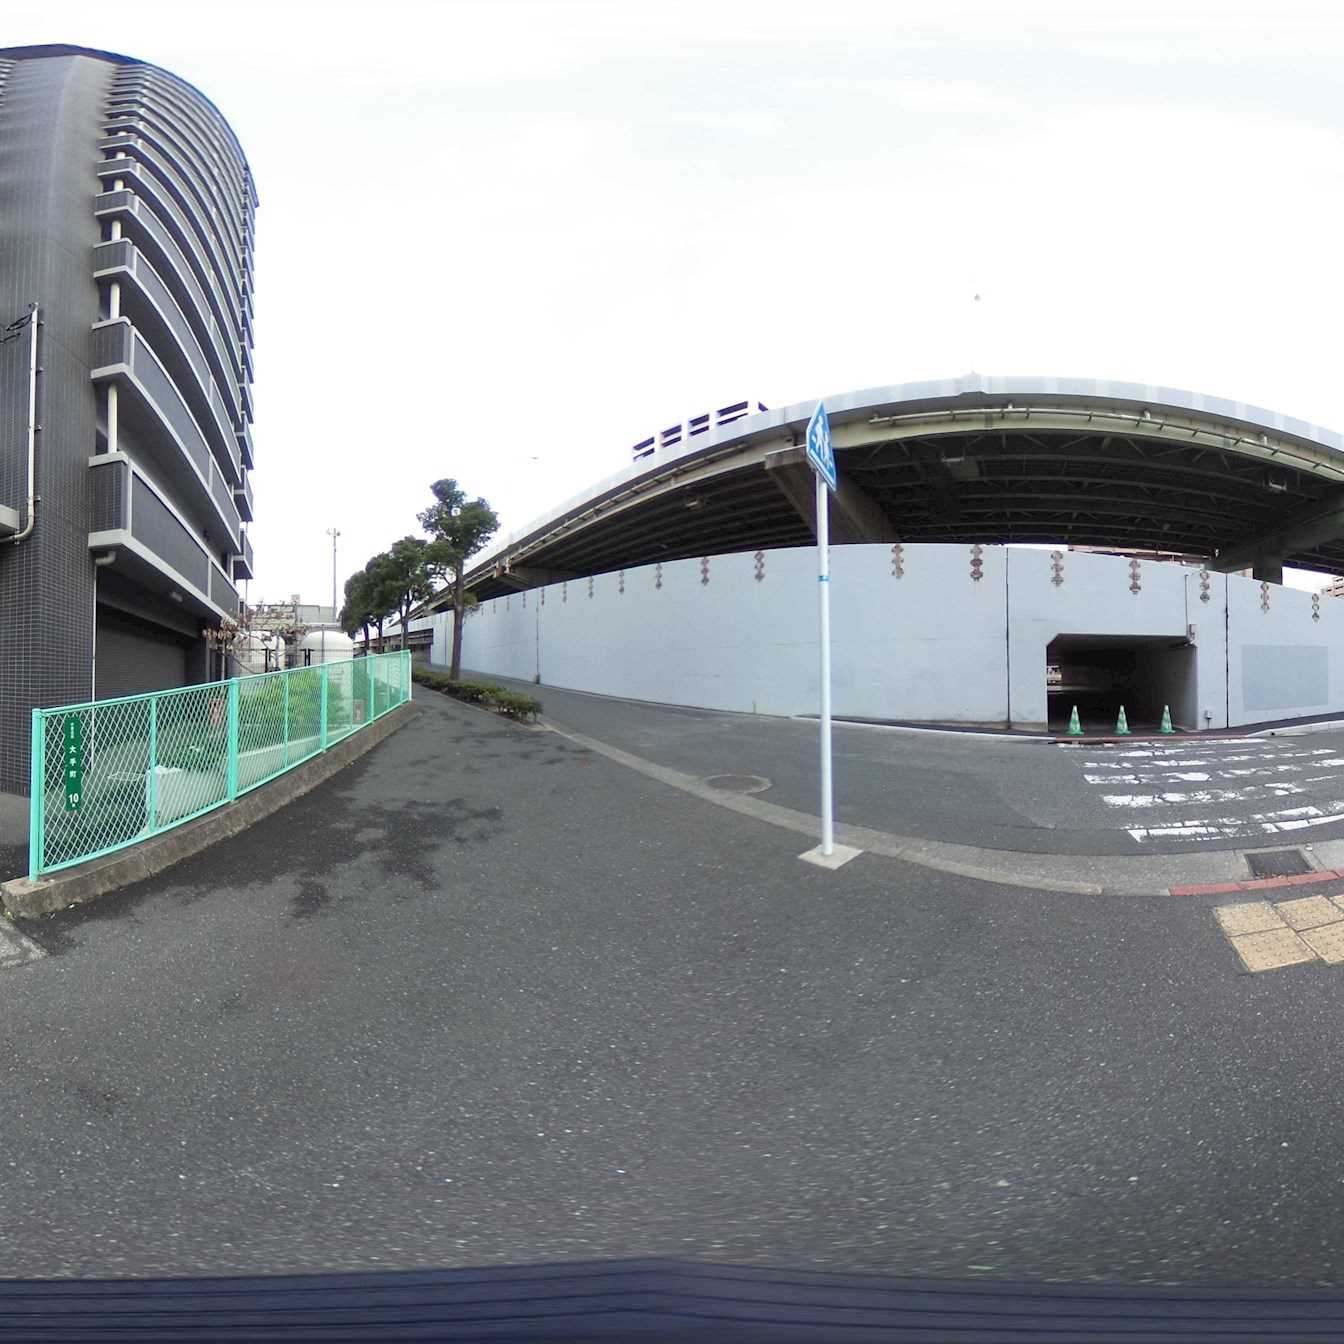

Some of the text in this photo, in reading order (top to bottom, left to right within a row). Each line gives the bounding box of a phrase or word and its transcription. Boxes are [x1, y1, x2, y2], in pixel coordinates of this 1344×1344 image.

[69, 746, 77, 778] 大手町
[69, 793, 79, 803] 10
